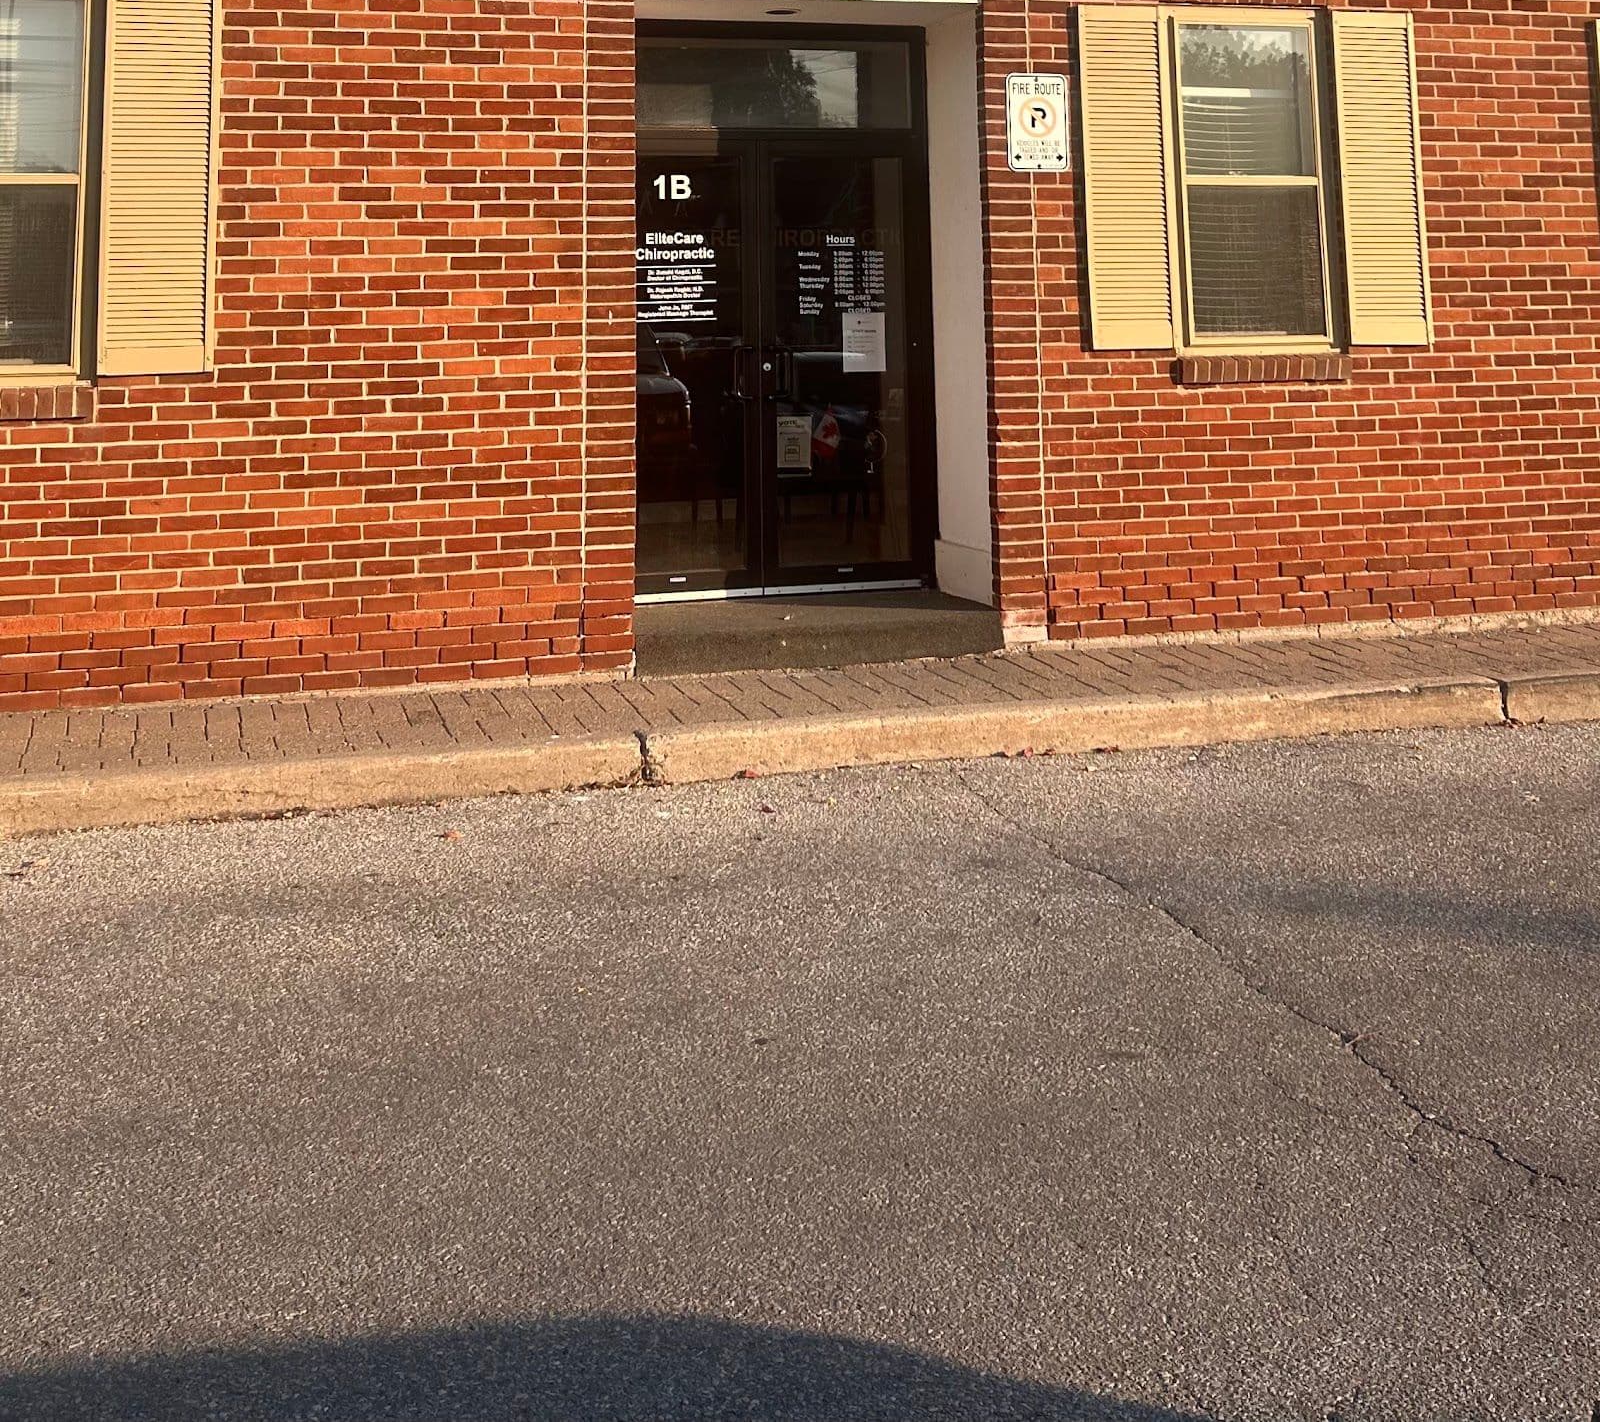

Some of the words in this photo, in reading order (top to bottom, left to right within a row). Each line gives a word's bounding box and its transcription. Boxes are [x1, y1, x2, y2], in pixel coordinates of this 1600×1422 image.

[1012, 83, 1030, 95] FIRE
[1034, 83, 1062, 95] ROUTE
[653, 174, 692, 200] 1B
[645, 232, 705, 246] EliteCare
[826, 234, 856, 244] Hours
[636, 247, 715, 262] Chiropractic
